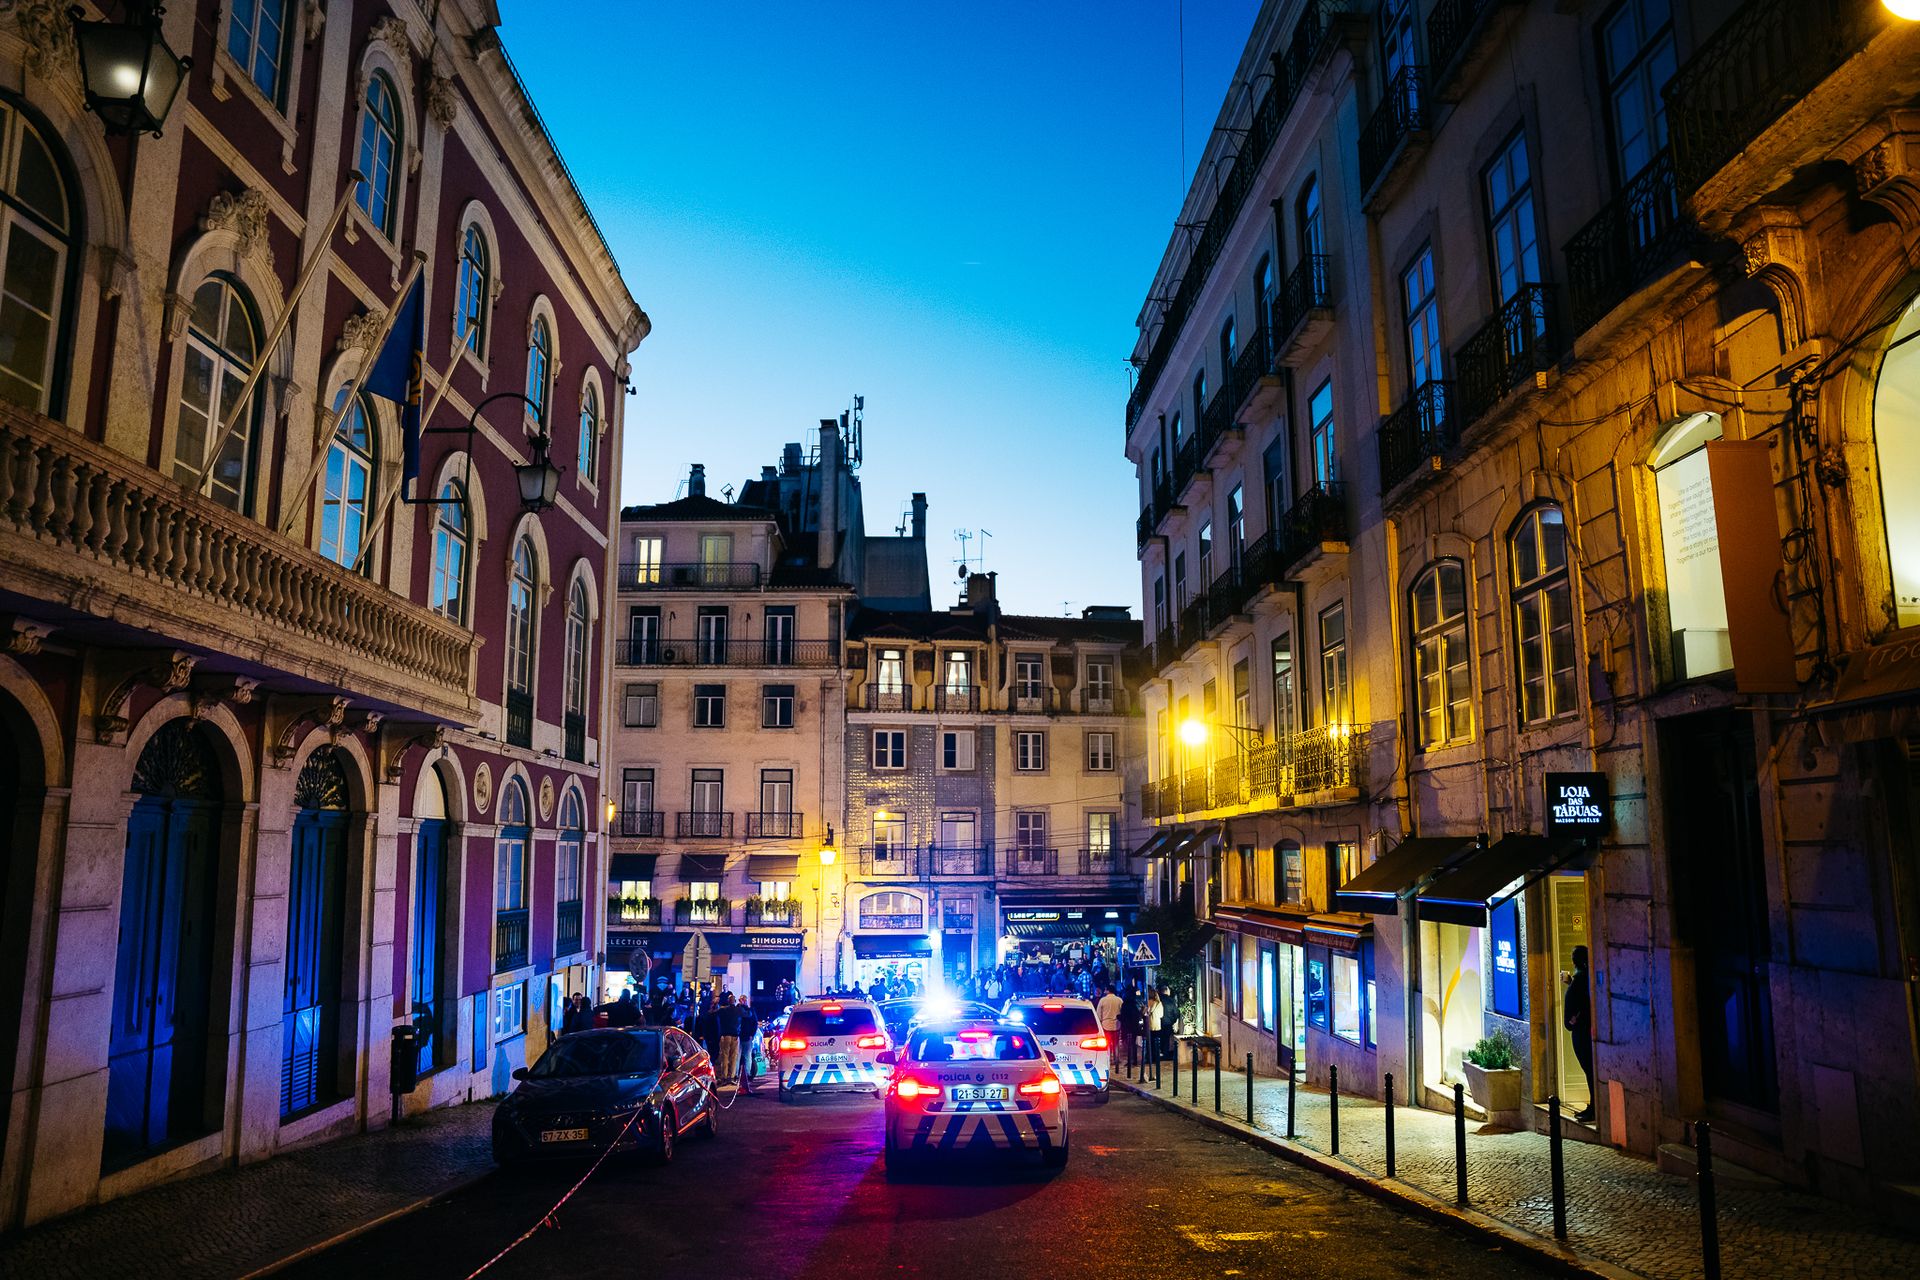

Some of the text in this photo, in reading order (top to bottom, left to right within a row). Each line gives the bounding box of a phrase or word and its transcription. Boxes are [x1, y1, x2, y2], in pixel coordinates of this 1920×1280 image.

[1560, 786, 1590, 798] LOJA
[1568, 797, 1583, 806] DAS
[938, 1072, 970, 1081] POLÍCIA
